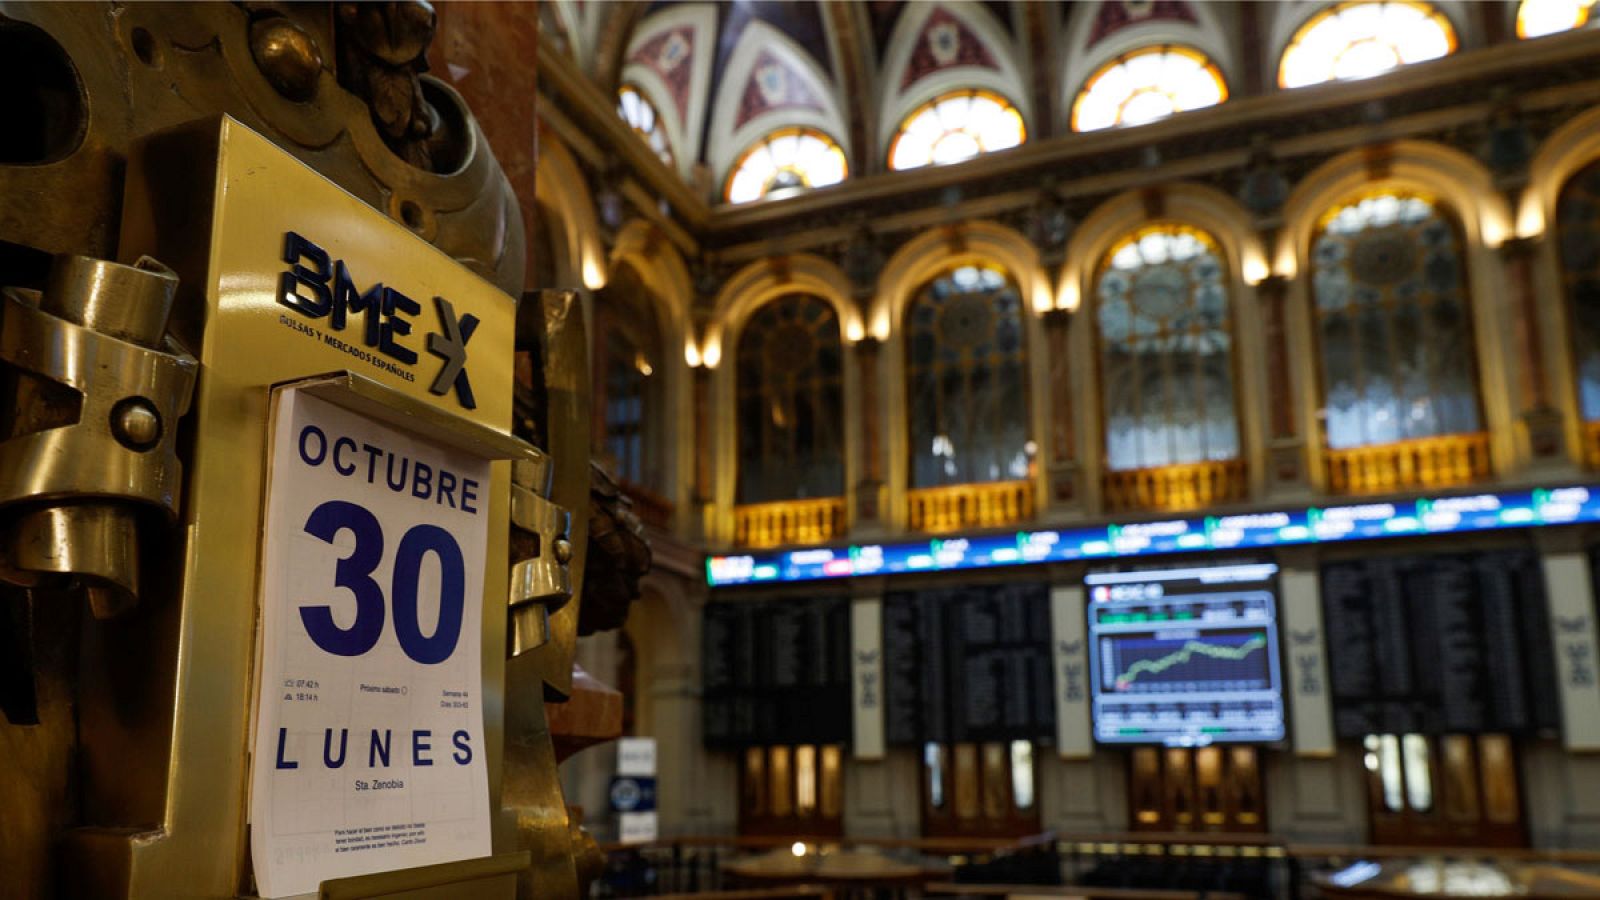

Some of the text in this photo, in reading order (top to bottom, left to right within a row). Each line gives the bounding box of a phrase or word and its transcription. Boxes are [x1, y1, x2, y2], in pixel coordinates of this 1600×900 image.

[280, 315, 415, 382] BOLSAS Y MERCADOS ESPAÑOLES
[298, 424, 479, 514] OCTUBRE
[298, 500, 465, 665] 30
[275, 727, 473, 769] LUNES
[372, 779, 404, 790] Zenobia
